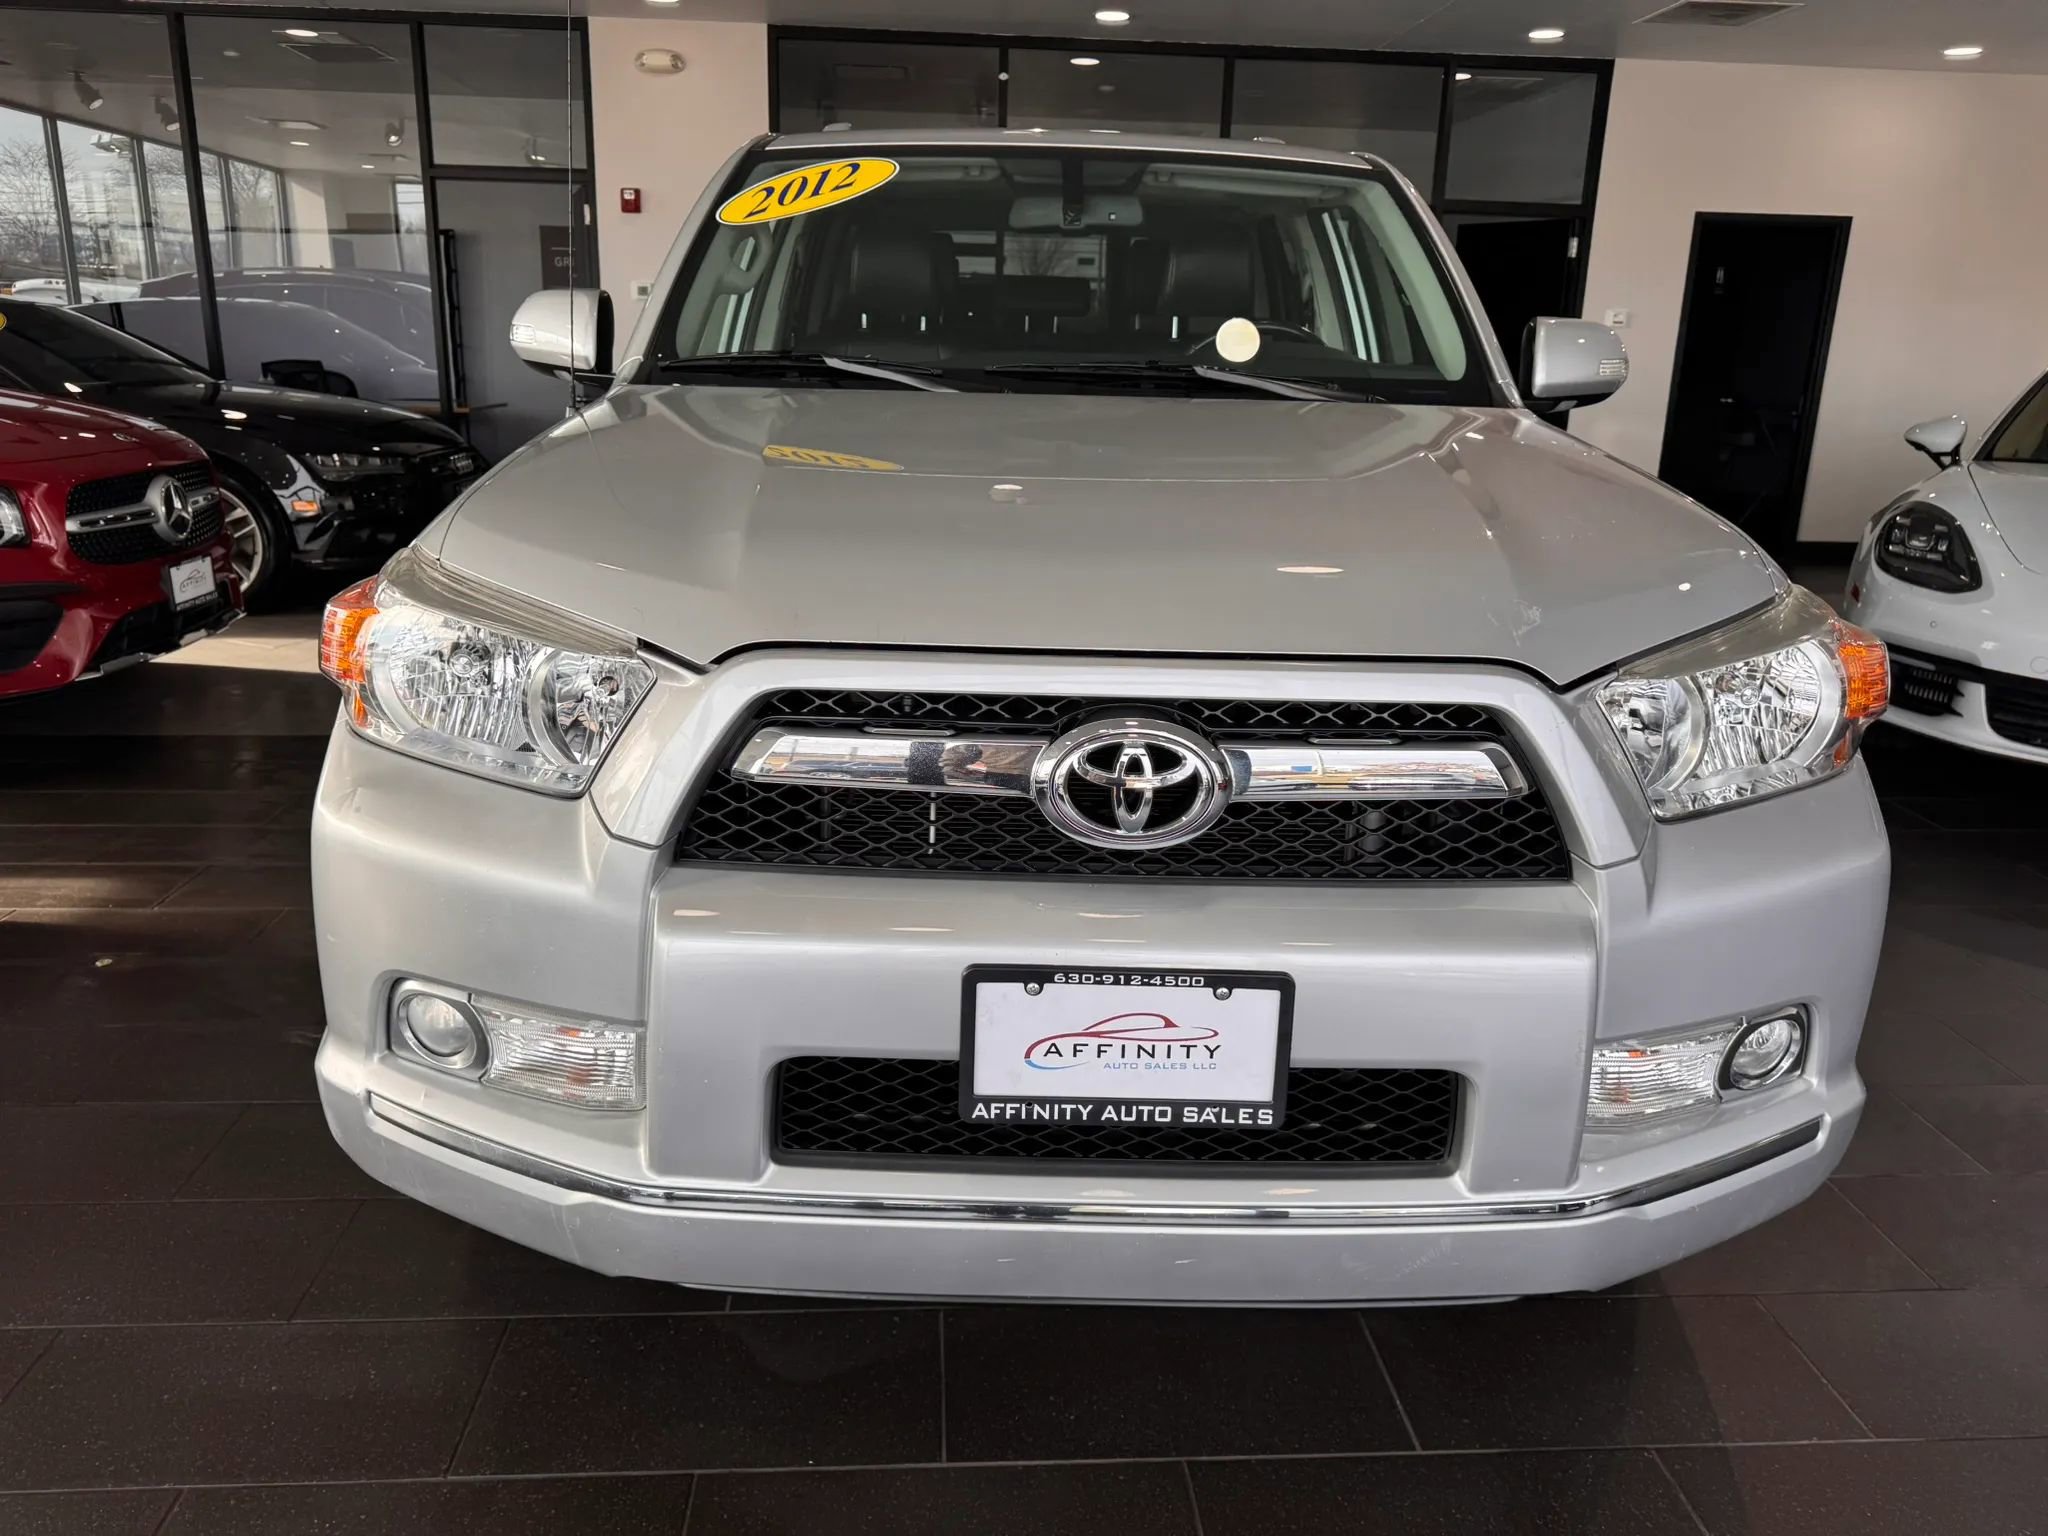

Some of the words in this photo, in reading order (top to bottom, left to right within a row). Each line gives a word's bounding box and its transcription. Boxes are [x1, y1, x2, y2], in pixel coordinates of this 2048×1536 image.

[742, 162, 861, 220] 2012
[1053, 973, 1205, 987] 630-912-4500
[1043, 1042, 1222, 1060] AFFINITY
[1103, 1062, 1139, 1070] AUTO
[1144, 1062, 1187, 1070] SALES
[1193, 1062, 1217, 1070] LLC
[971, 1102, 1094, 1121] AFFINITY
[1101, 1104, 1172, 1122] AUTO
[1182, 1106, 1274, 1126] SALES
